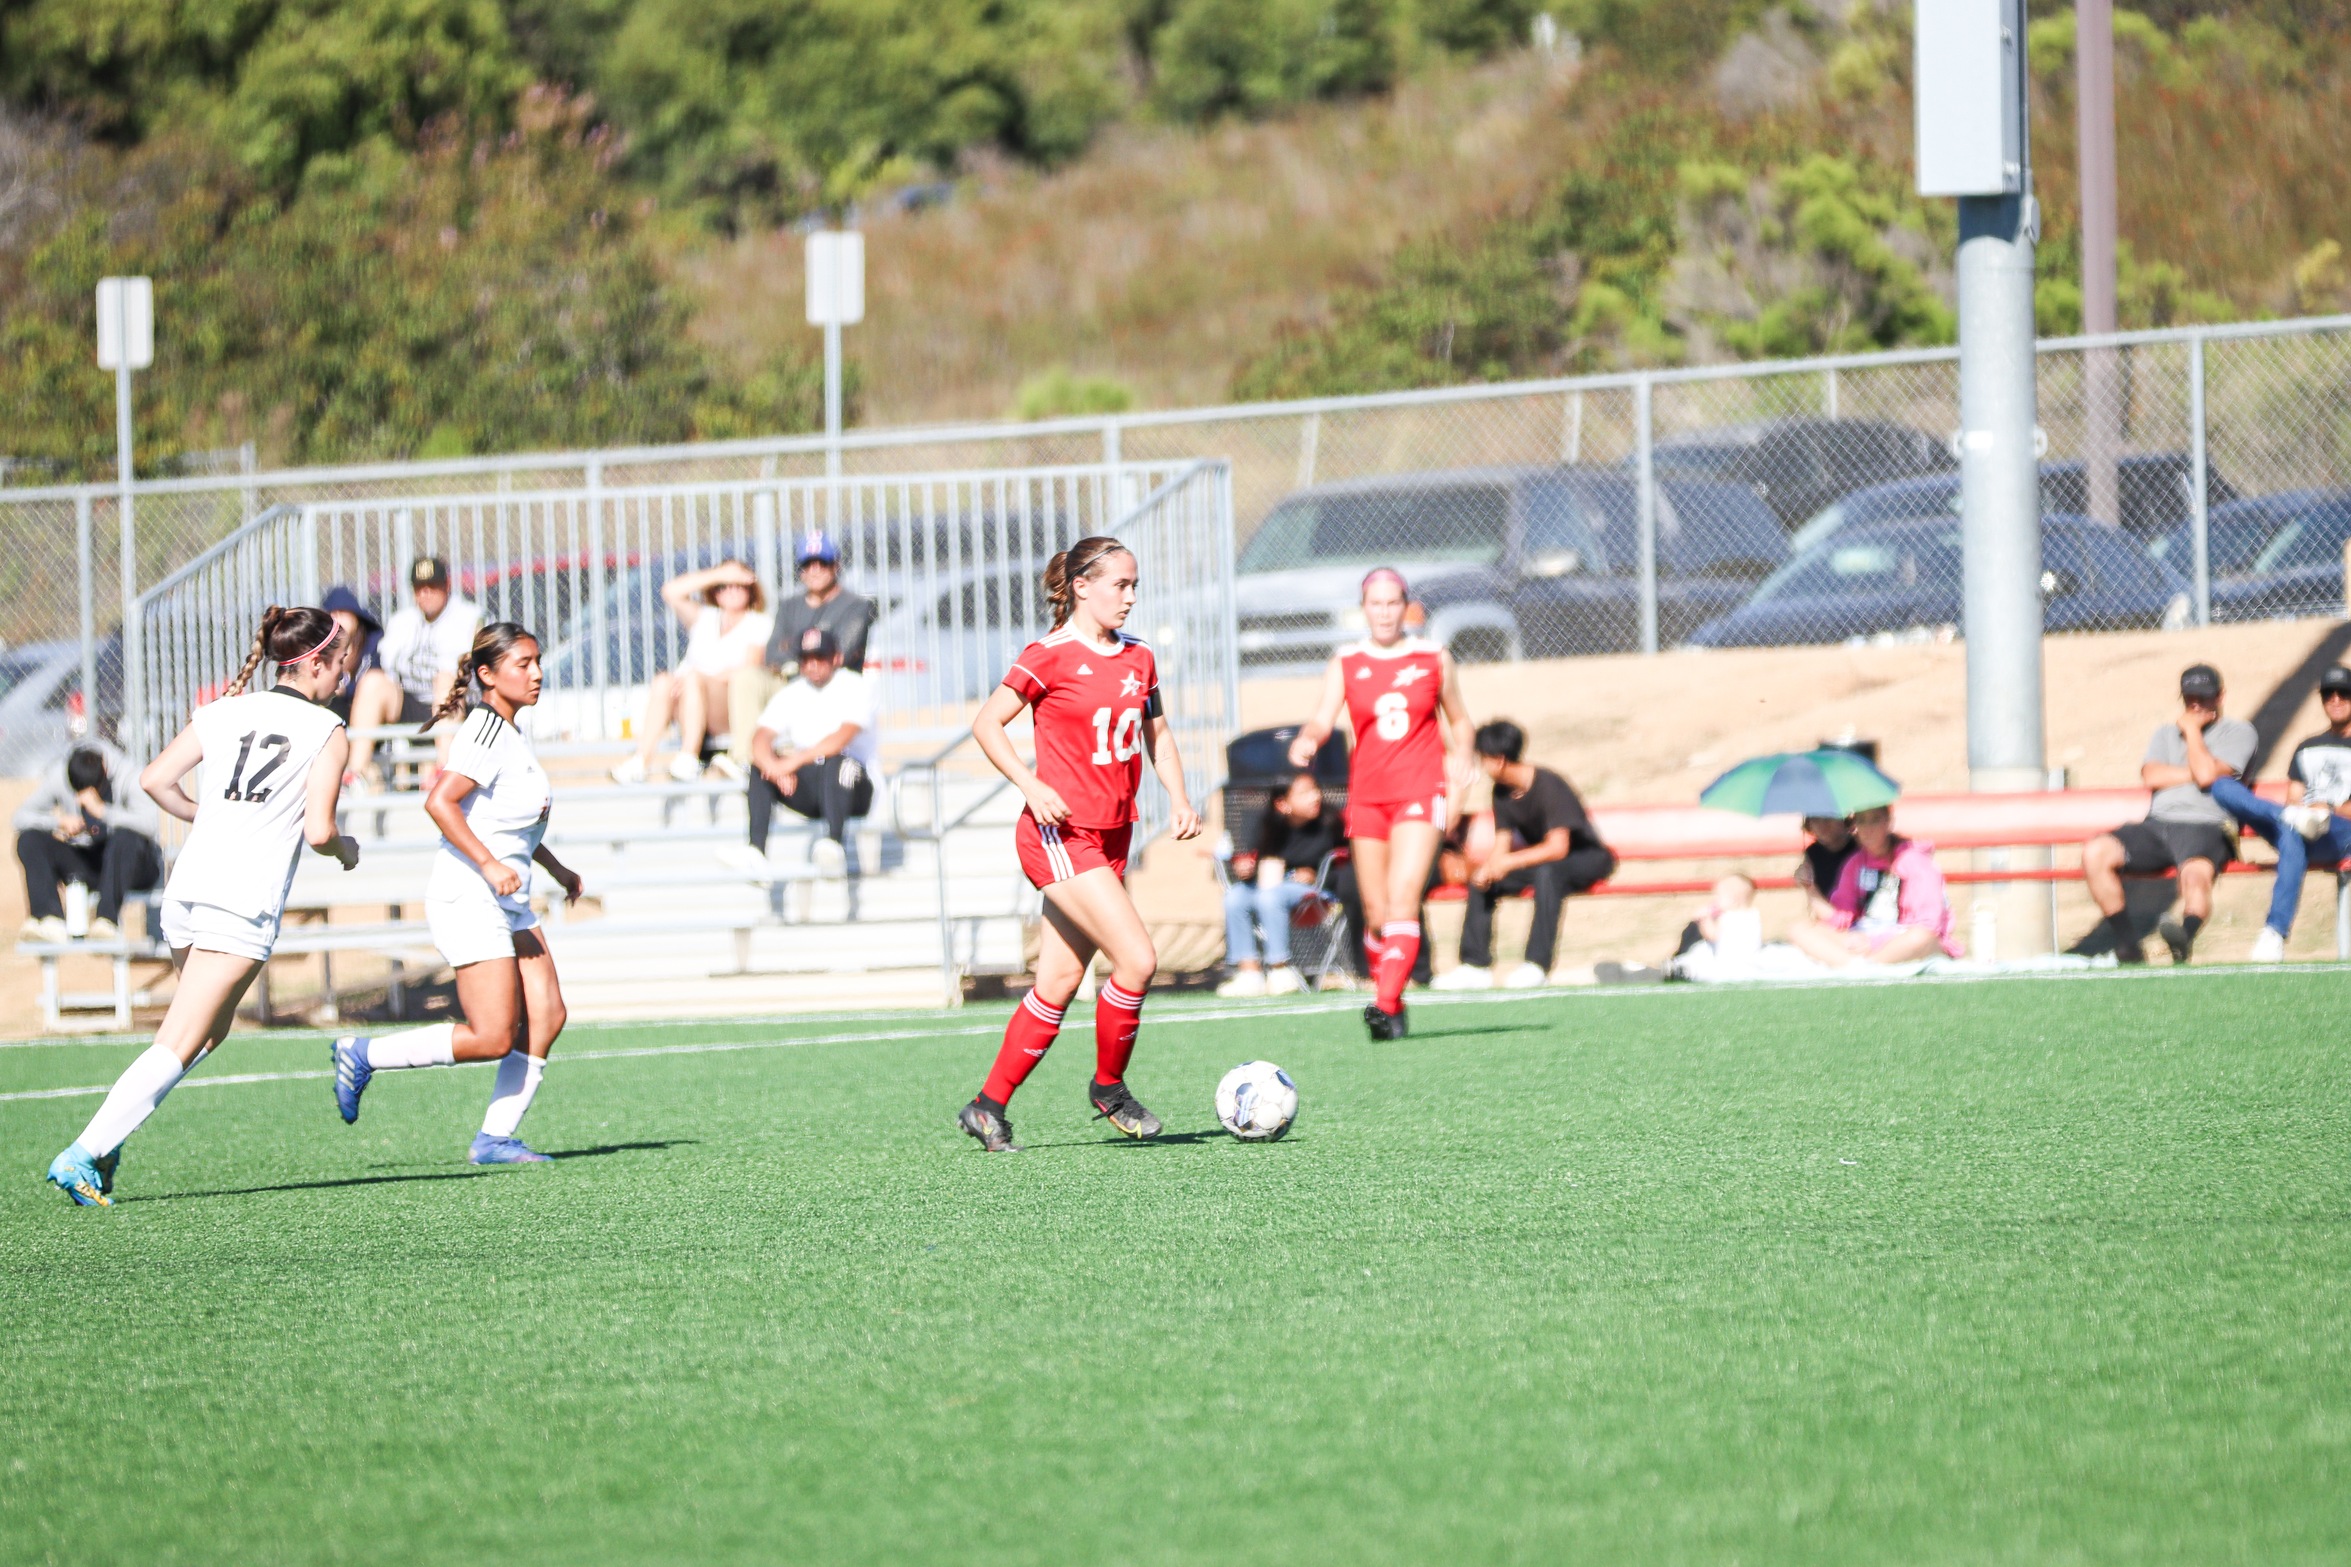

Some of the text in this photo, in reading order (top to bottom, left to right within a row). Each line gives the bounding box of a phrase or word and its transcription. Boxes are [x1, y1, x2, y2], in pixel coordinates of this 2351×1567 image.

[1092, 707, 1142, 765] 10
[1374, 692, 1410, 741] 6
[224, 730, 291, 803] 12
